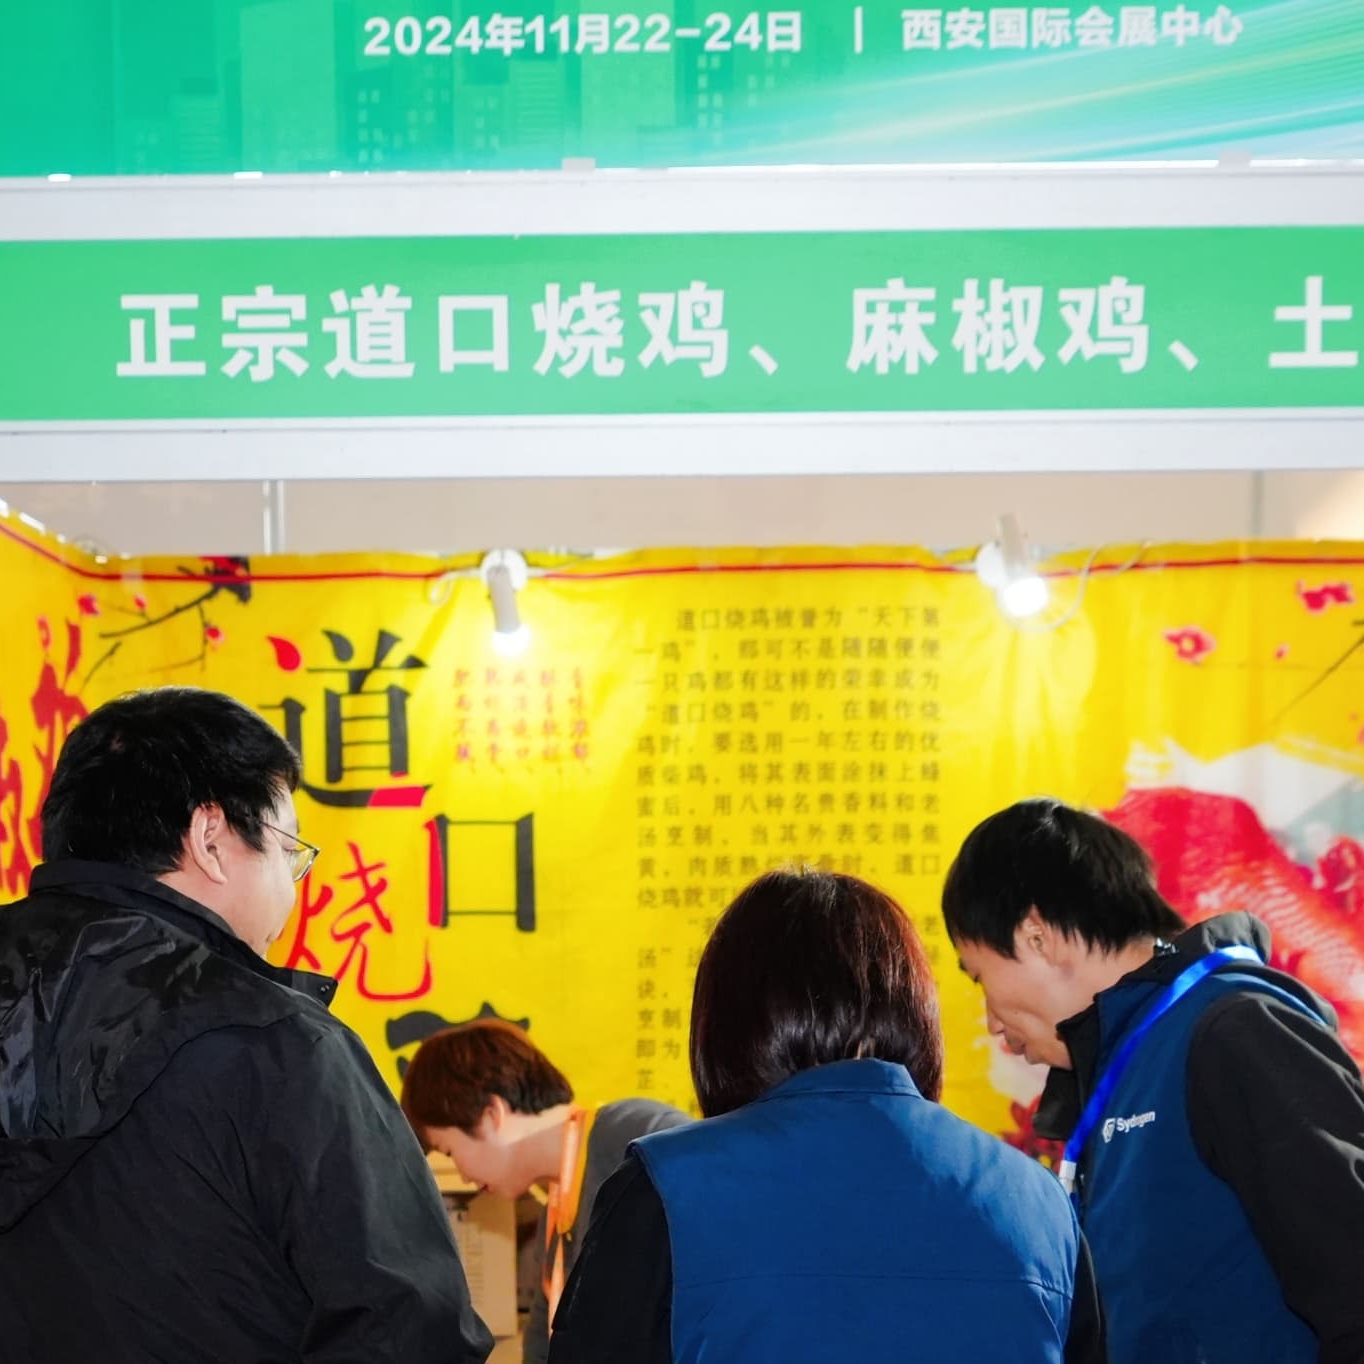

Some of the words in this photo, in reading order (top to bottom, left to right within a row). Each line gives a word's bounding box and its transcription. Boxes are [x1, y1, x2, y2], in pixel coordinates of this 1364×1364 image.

[363, 12, 804, 56] 2024年11月22-24日
[900, 3, 1244, 51] 西安国际会展中心
